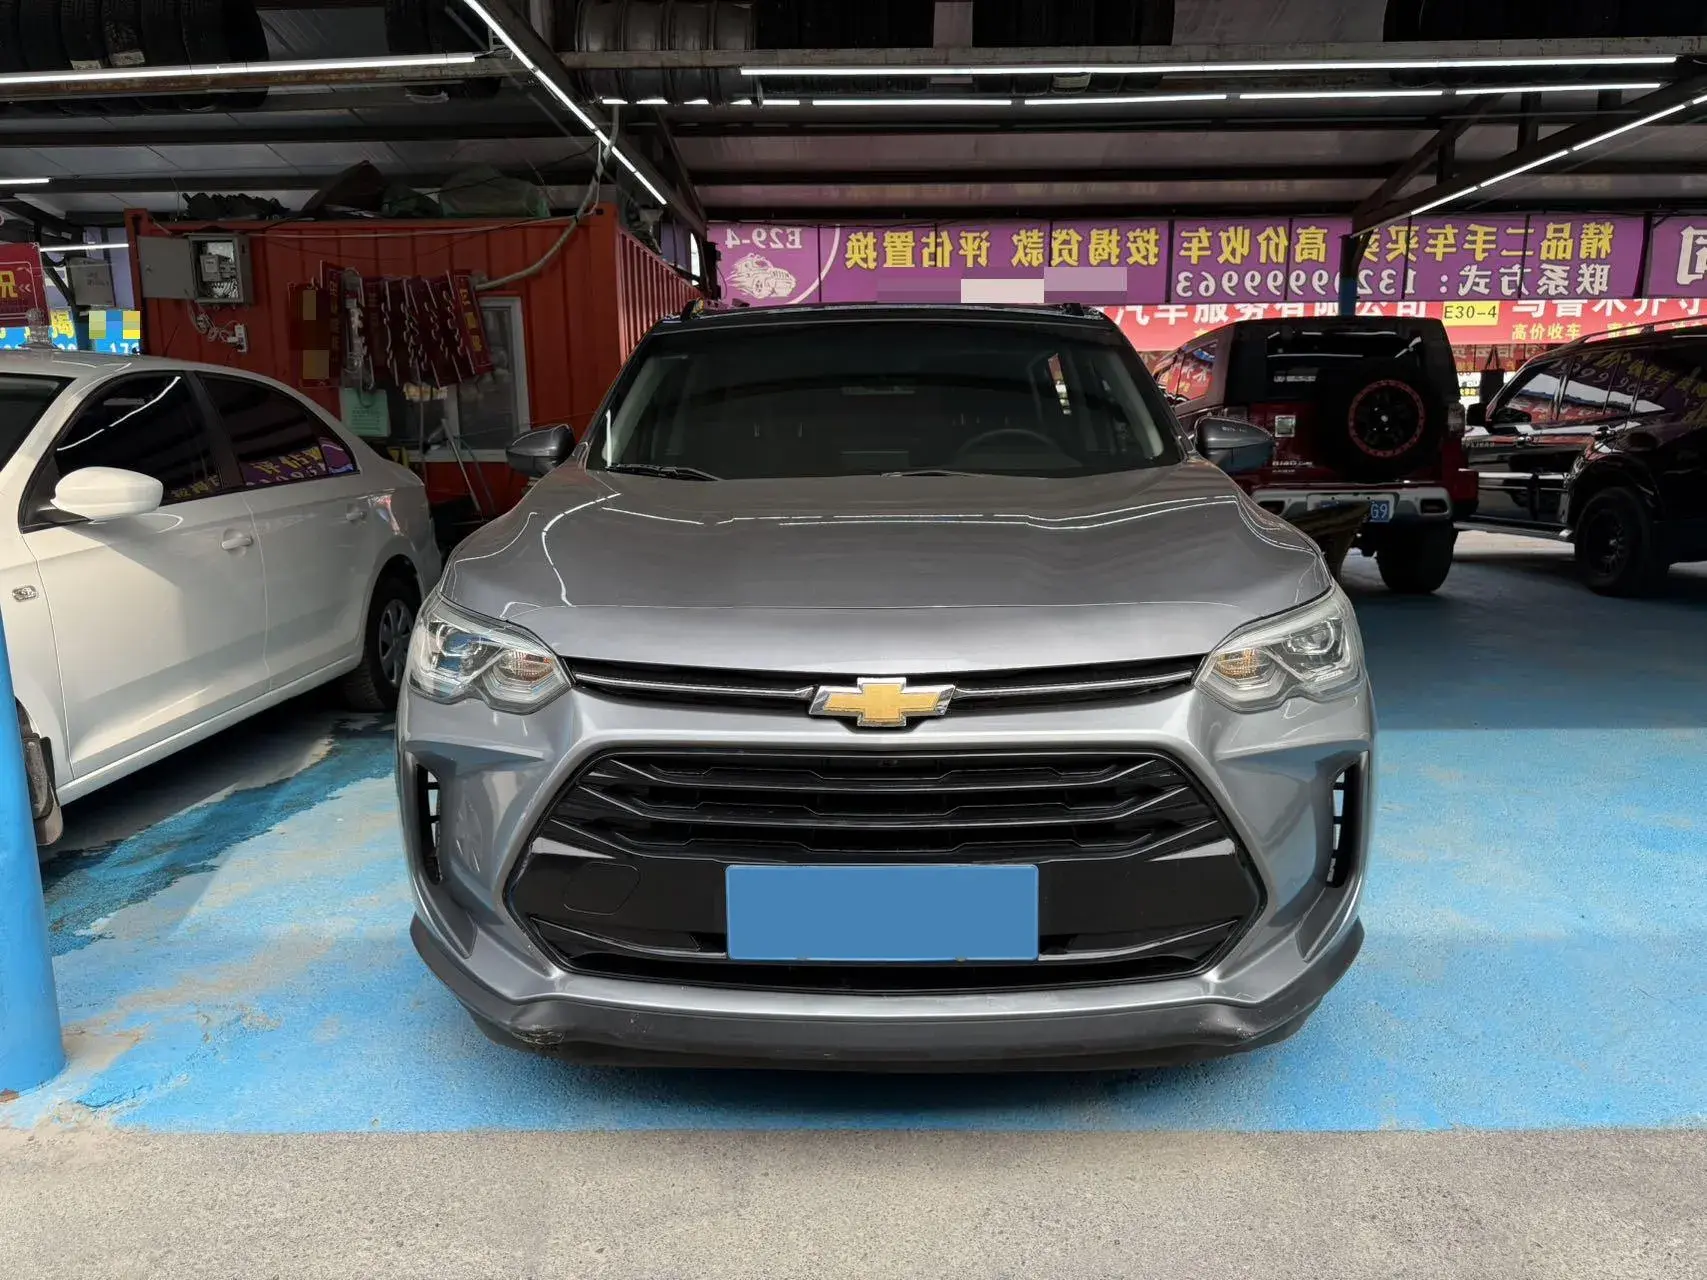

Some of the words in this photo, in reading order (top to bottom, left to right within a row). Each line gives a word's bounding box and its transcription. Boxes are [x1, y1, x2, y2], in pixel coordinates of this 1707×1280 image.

[1444, 305, 1498, 319] E30-4
[1512, 323, 1582, 340] 高价收车
